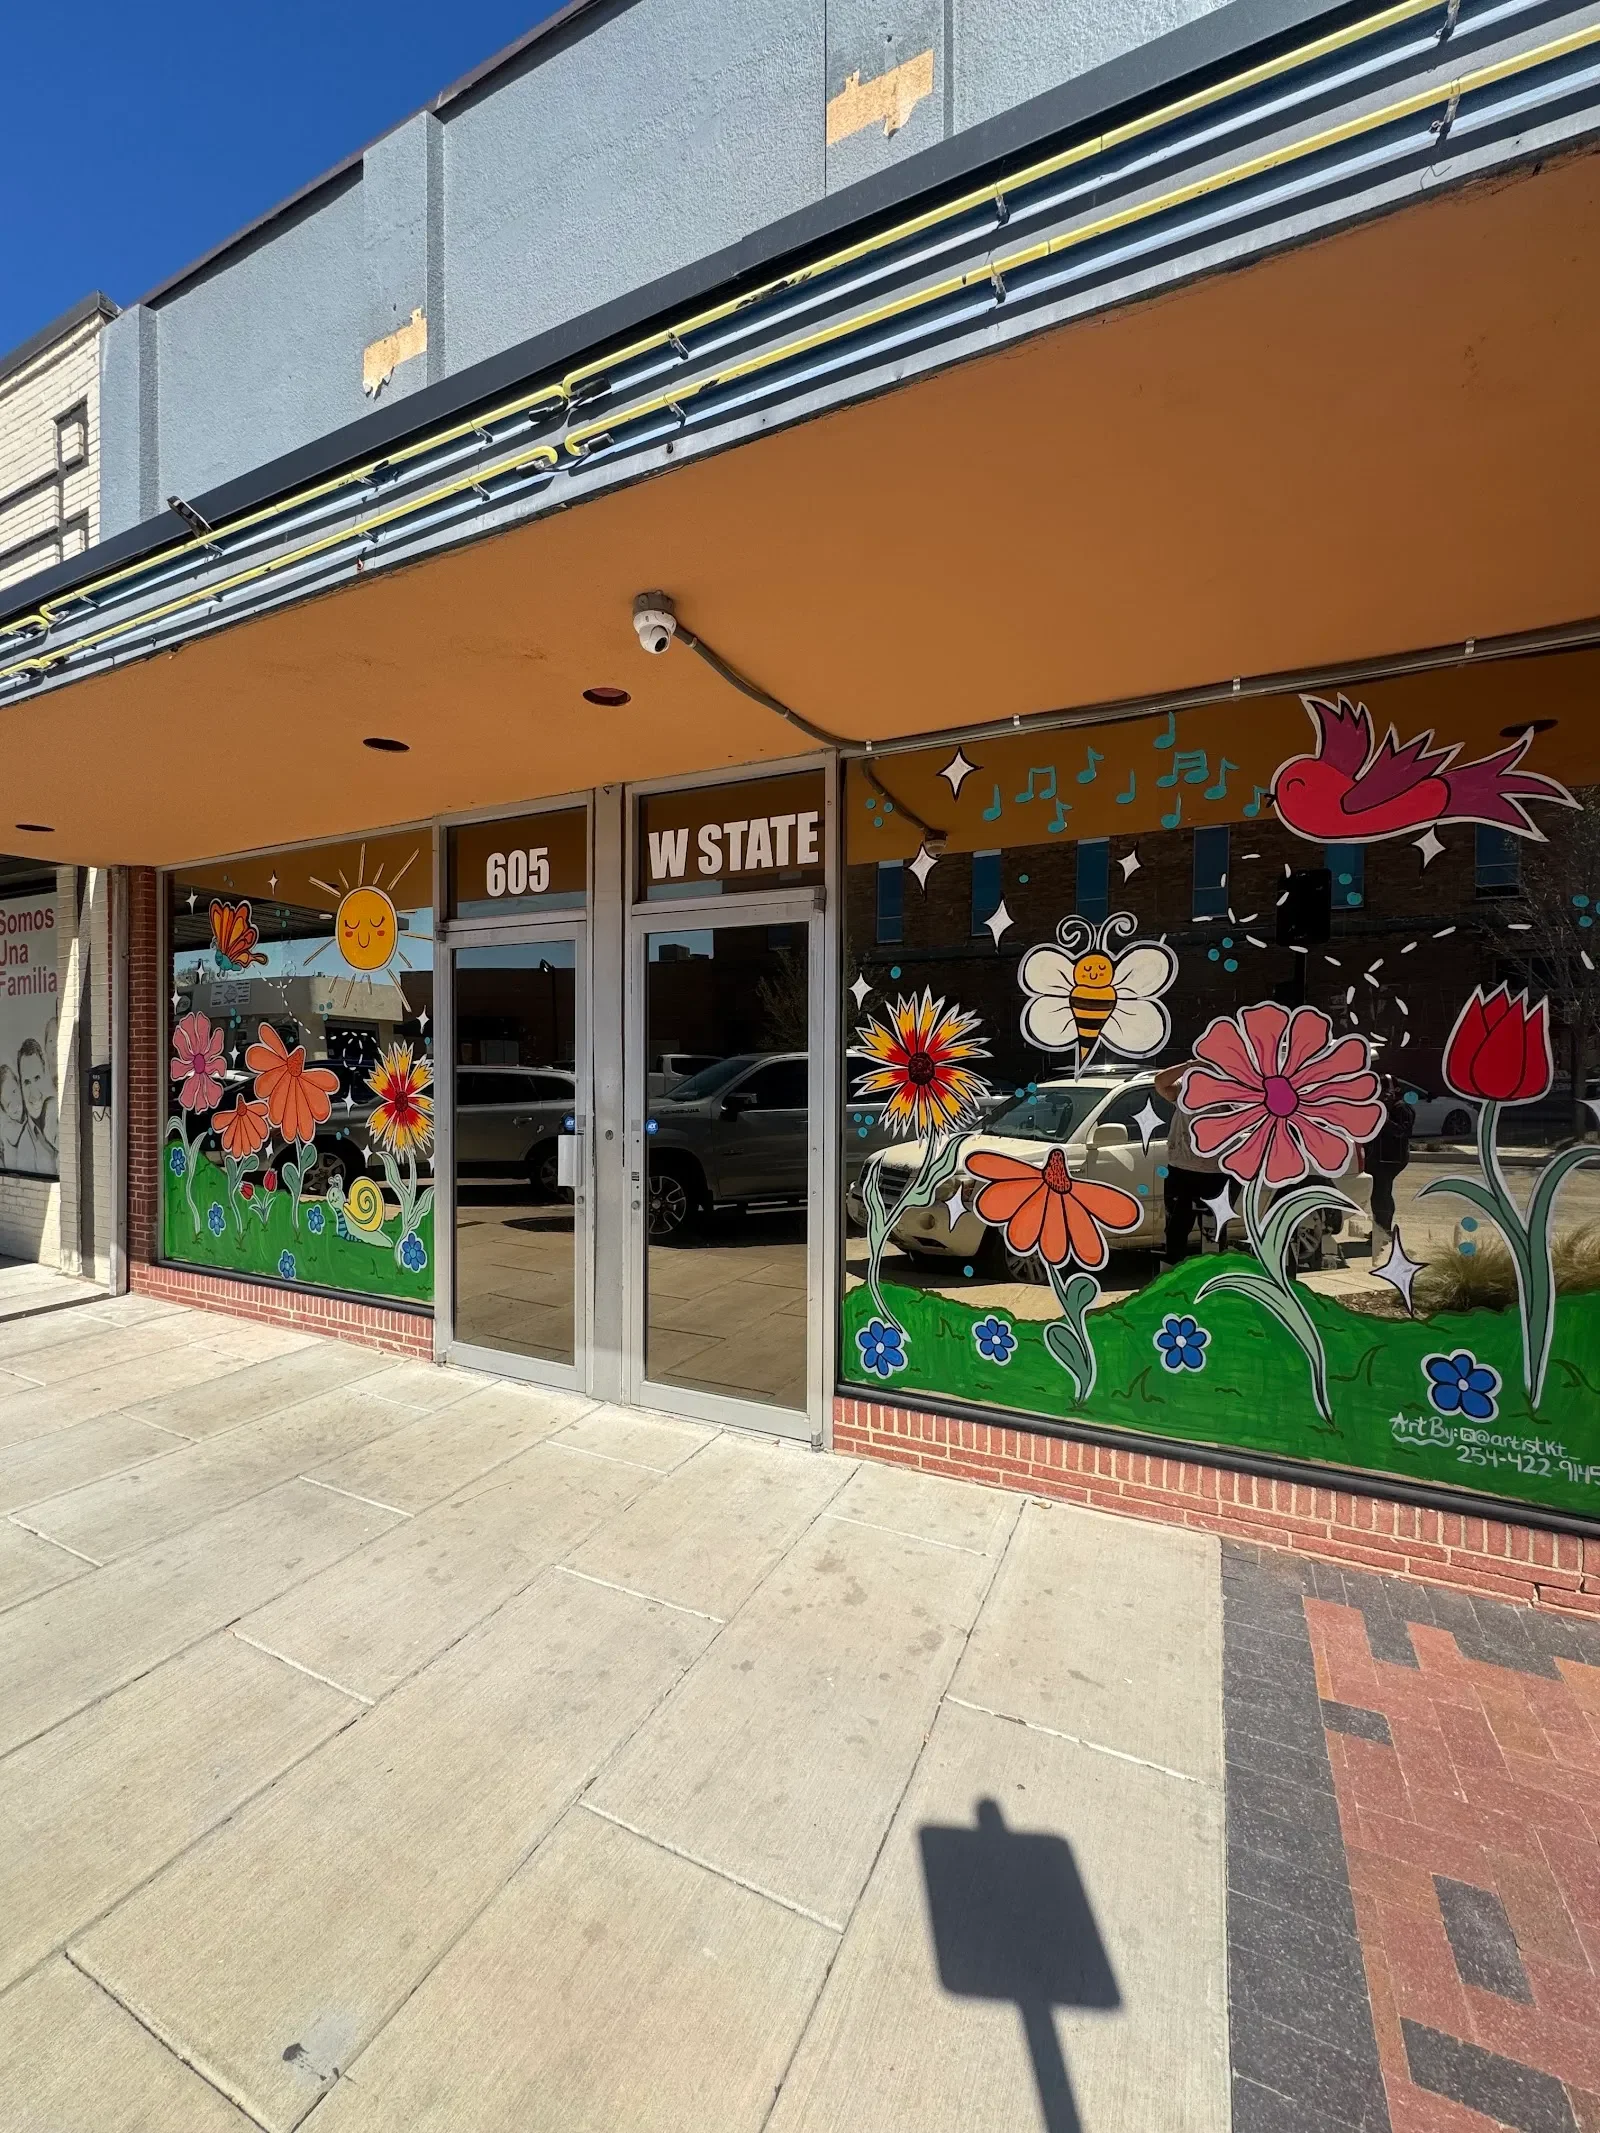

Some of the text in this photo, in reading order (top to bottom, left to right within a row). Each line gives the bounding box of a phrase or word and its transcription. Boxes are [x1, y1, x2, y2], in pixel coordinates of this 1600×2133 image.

[648, 811, 819, 880] W STATE
[487, 847, 549, 897] 605
[0, 908, 54, 936] Somos
[1389, 1412, 1427, 1436] Art
[1430, 1416, 1459, 1442] By:
